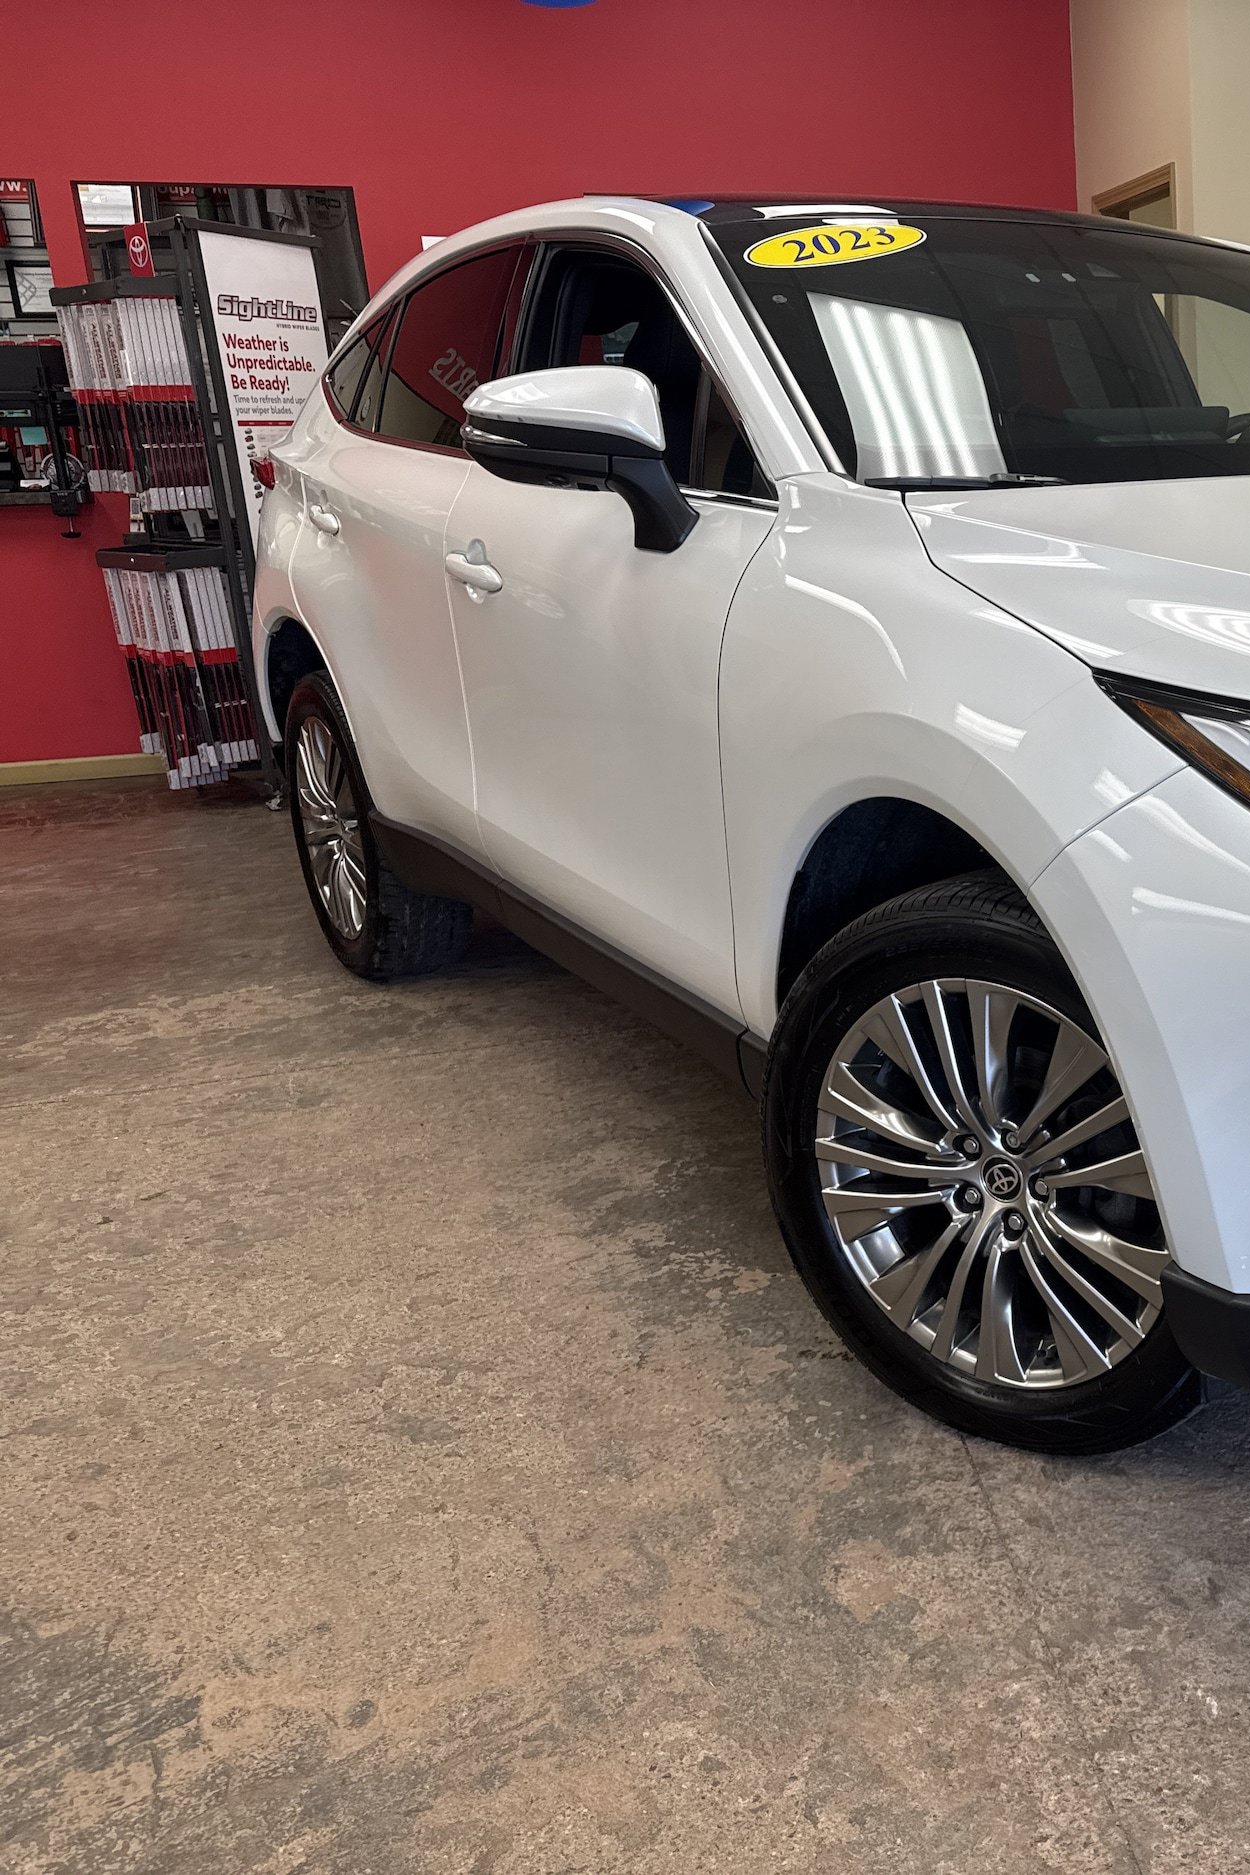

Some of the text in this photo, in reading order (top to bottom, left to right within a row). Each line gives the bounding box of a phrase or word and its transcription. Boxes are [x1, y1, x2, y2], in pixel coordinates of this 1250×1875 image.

[782, 226, 895, 263] 2023
[217, 294, 317, 323] SightLine
[222, 333, 289, 352] Weather is
[226, 353, 316, 373] Unpredictable.
[231, 374, 290, 394] Be Ready!
[233, 394, 250, 404] Time
[251, 395, 258, 404] to
[260, 395, 281, 404] refresh
[283, 396, 294, 404] and
[235, 406, 293, 417] your wiper blades.
